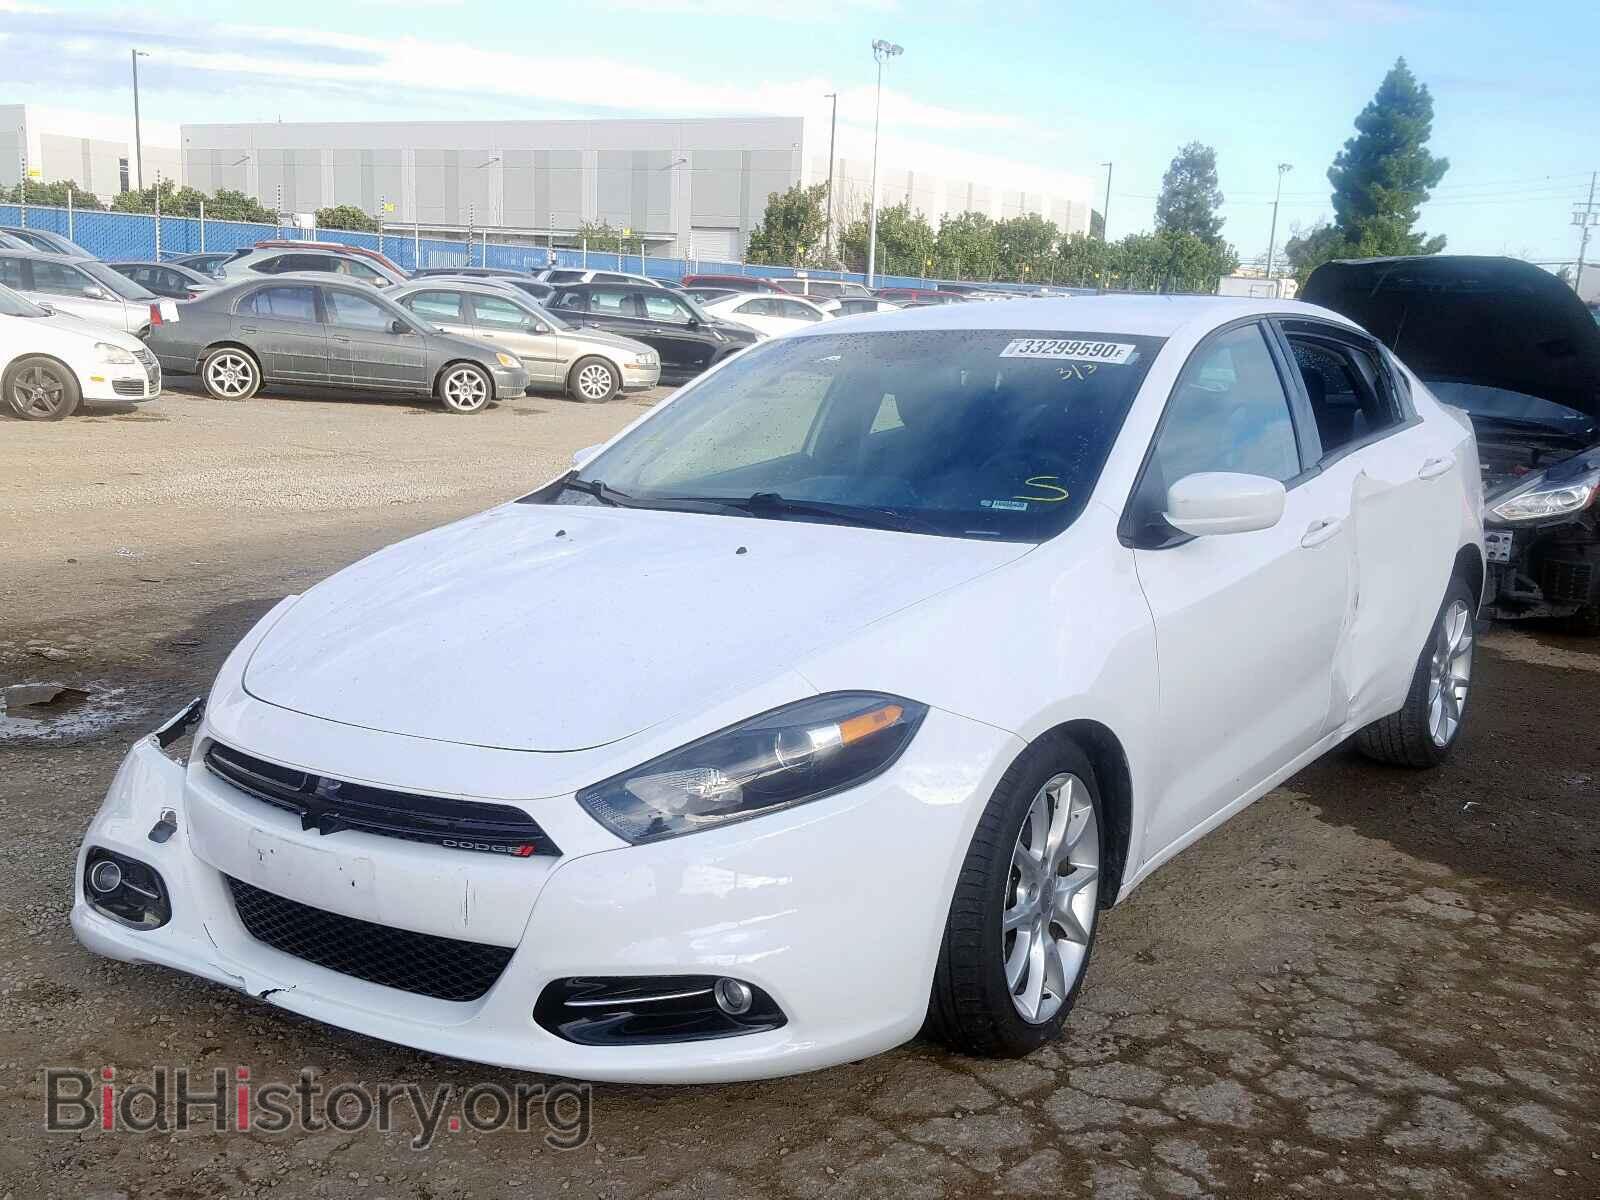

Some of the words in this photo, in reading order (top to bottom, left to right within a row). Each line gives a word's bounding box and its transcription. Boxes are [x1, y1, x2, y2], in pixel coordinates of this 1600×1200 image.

[1019, 340, 1117, 358] 33299590
[1012, 475, 1069, 502] S
[442, 839, 522, 855] DODGE
